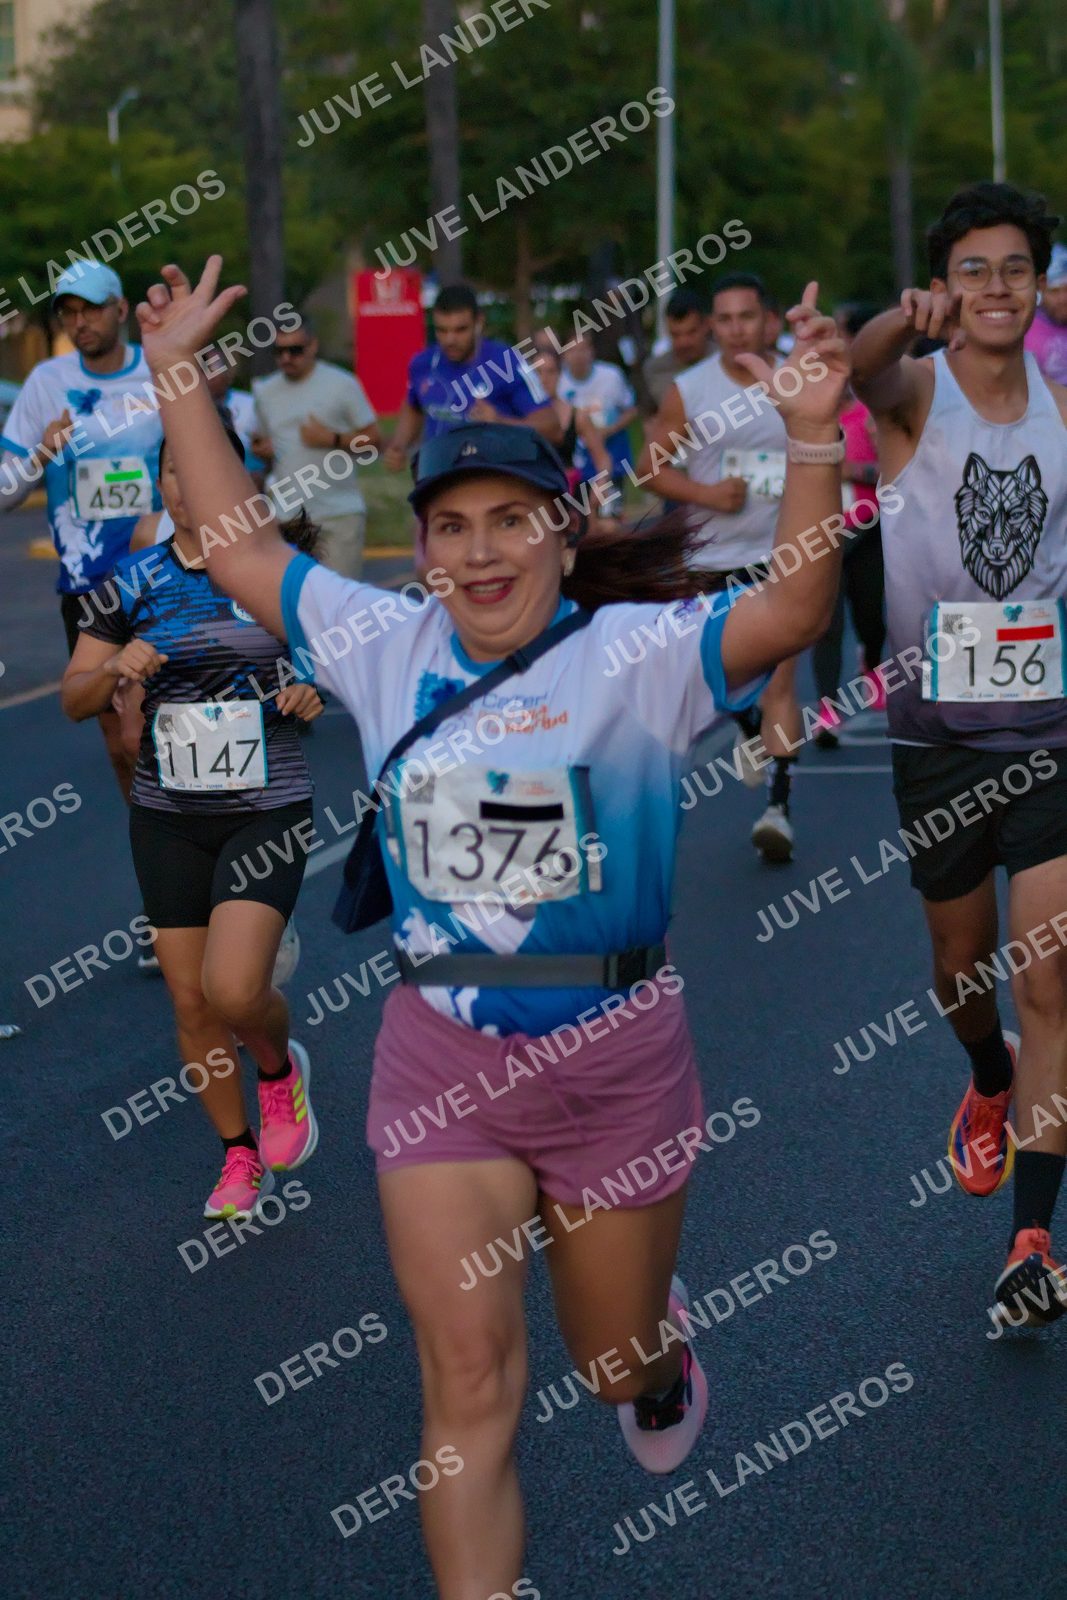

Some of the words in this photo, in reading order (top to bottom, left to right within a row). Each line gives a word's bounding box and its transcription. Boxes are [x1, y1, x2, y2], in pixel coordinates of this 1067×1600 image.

[89, 483, 143, 511] 452
[962, 643, 1046, 687] 156
[164, 739, 261, 778] 1147
[413, 819, 572, 882] 1376
